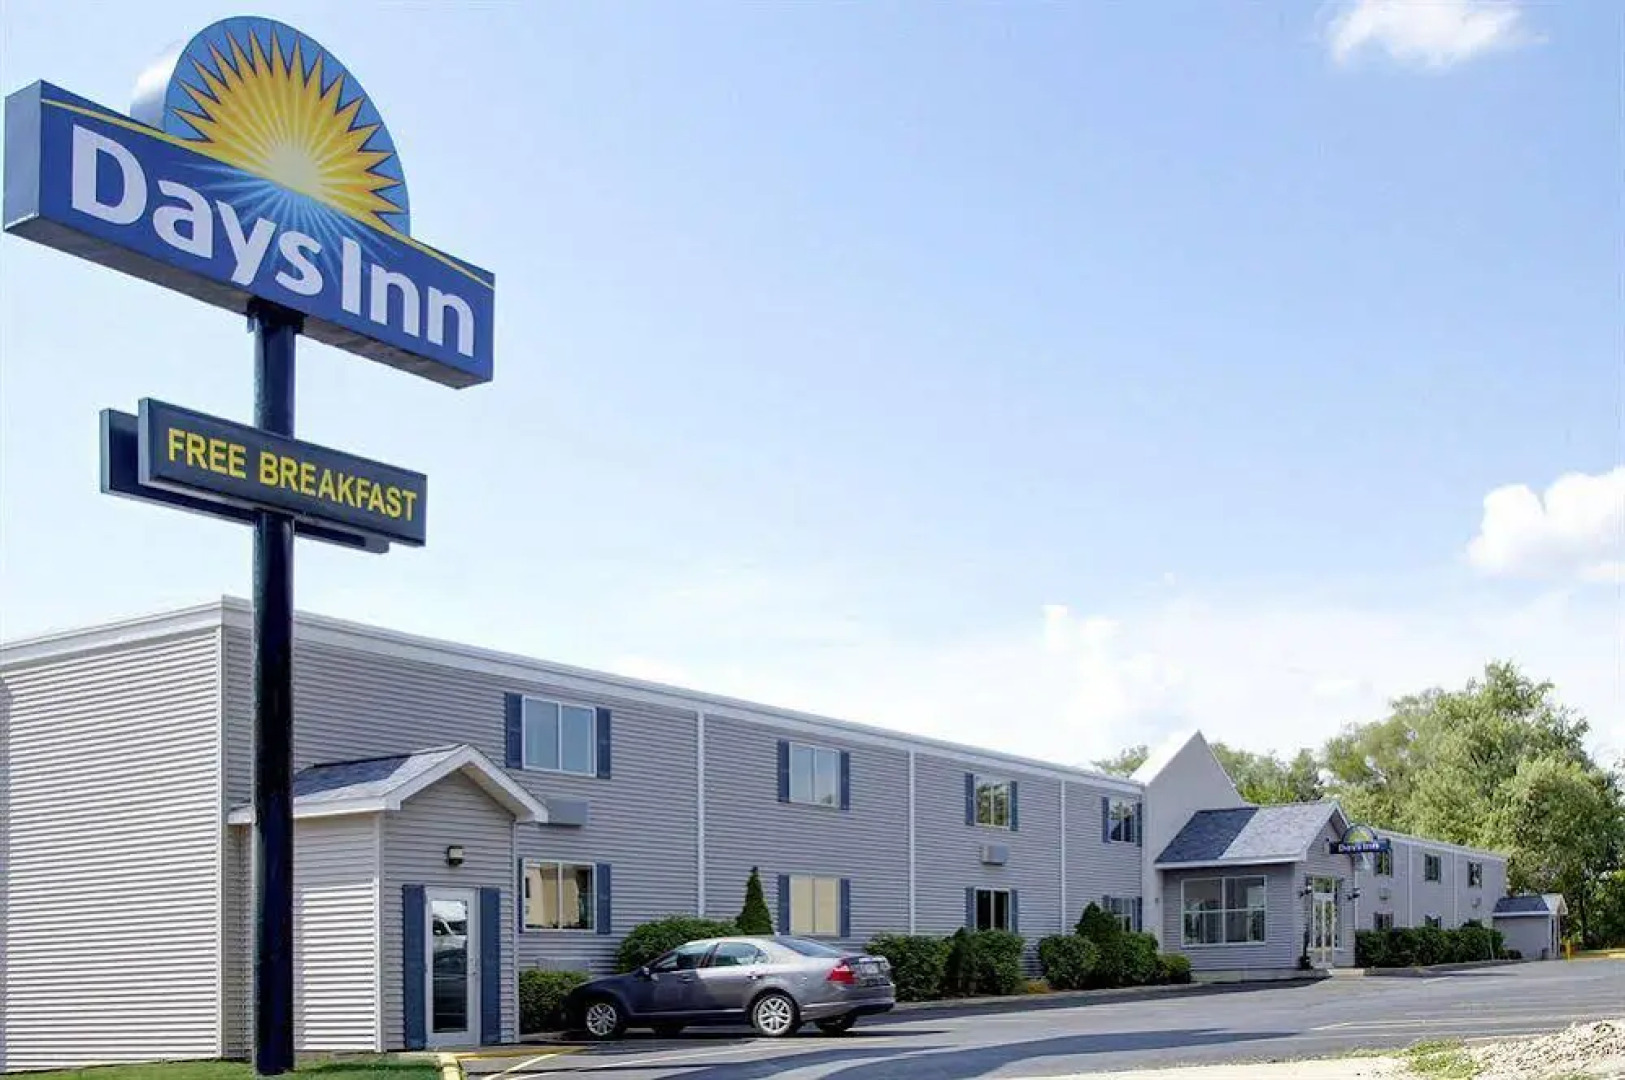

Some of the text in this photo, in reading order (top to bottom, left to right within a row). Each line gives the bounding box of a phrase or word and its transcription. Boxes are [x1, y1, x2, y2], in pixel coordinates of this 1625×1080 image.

[72, 124, 475, 358] Days Inn
[168, 428, 417, 521] FREE BREAKFAST
